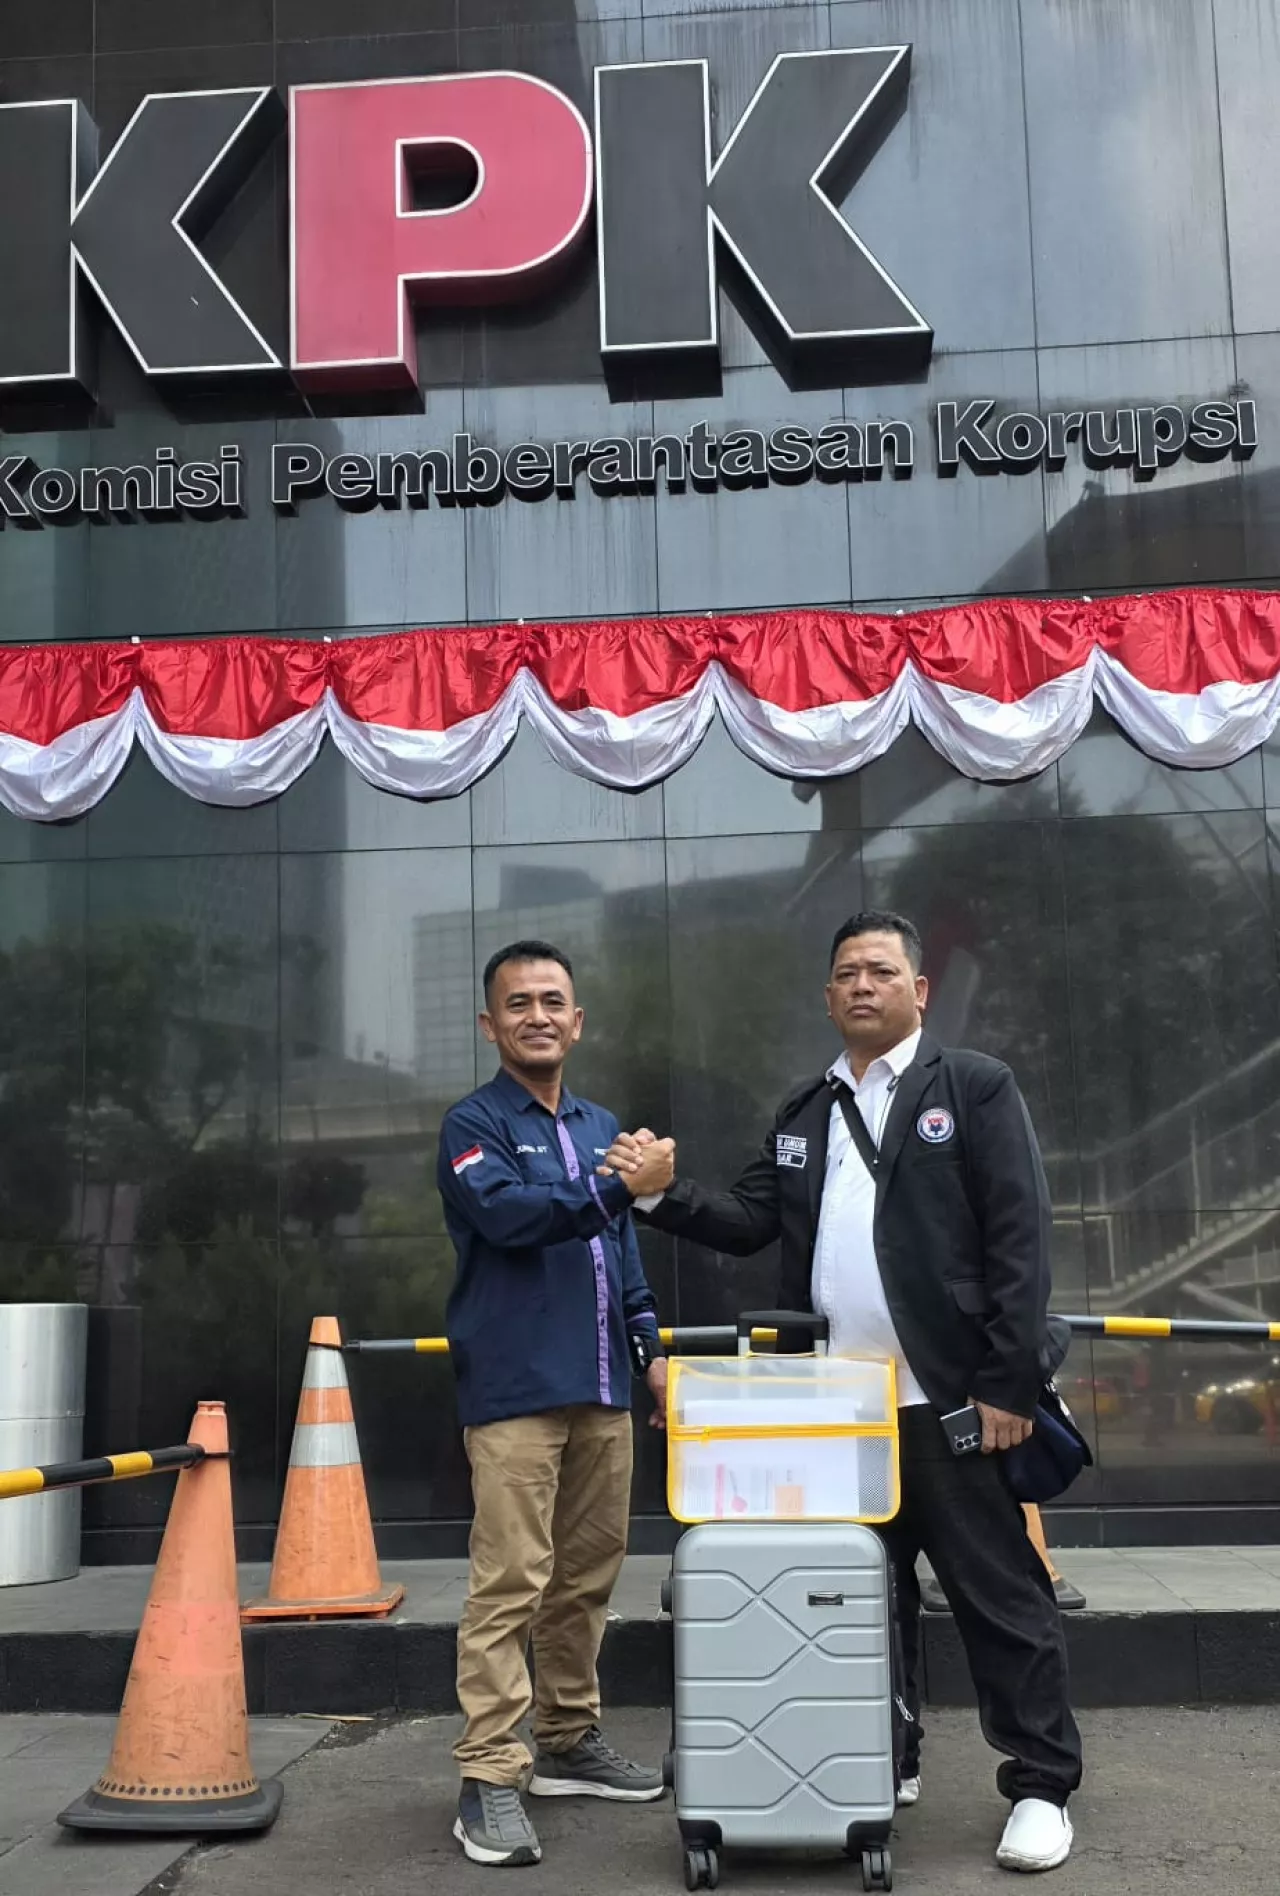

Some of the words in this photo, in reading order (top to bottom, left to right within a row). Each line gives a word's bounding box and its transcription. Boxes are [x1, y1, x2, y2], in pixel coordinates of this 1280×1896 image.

[0, 44, 934, 384] KPK
[271, 420, 914, 504] Pemberantasan
[937, 399, 1257, 468] Korupsi
